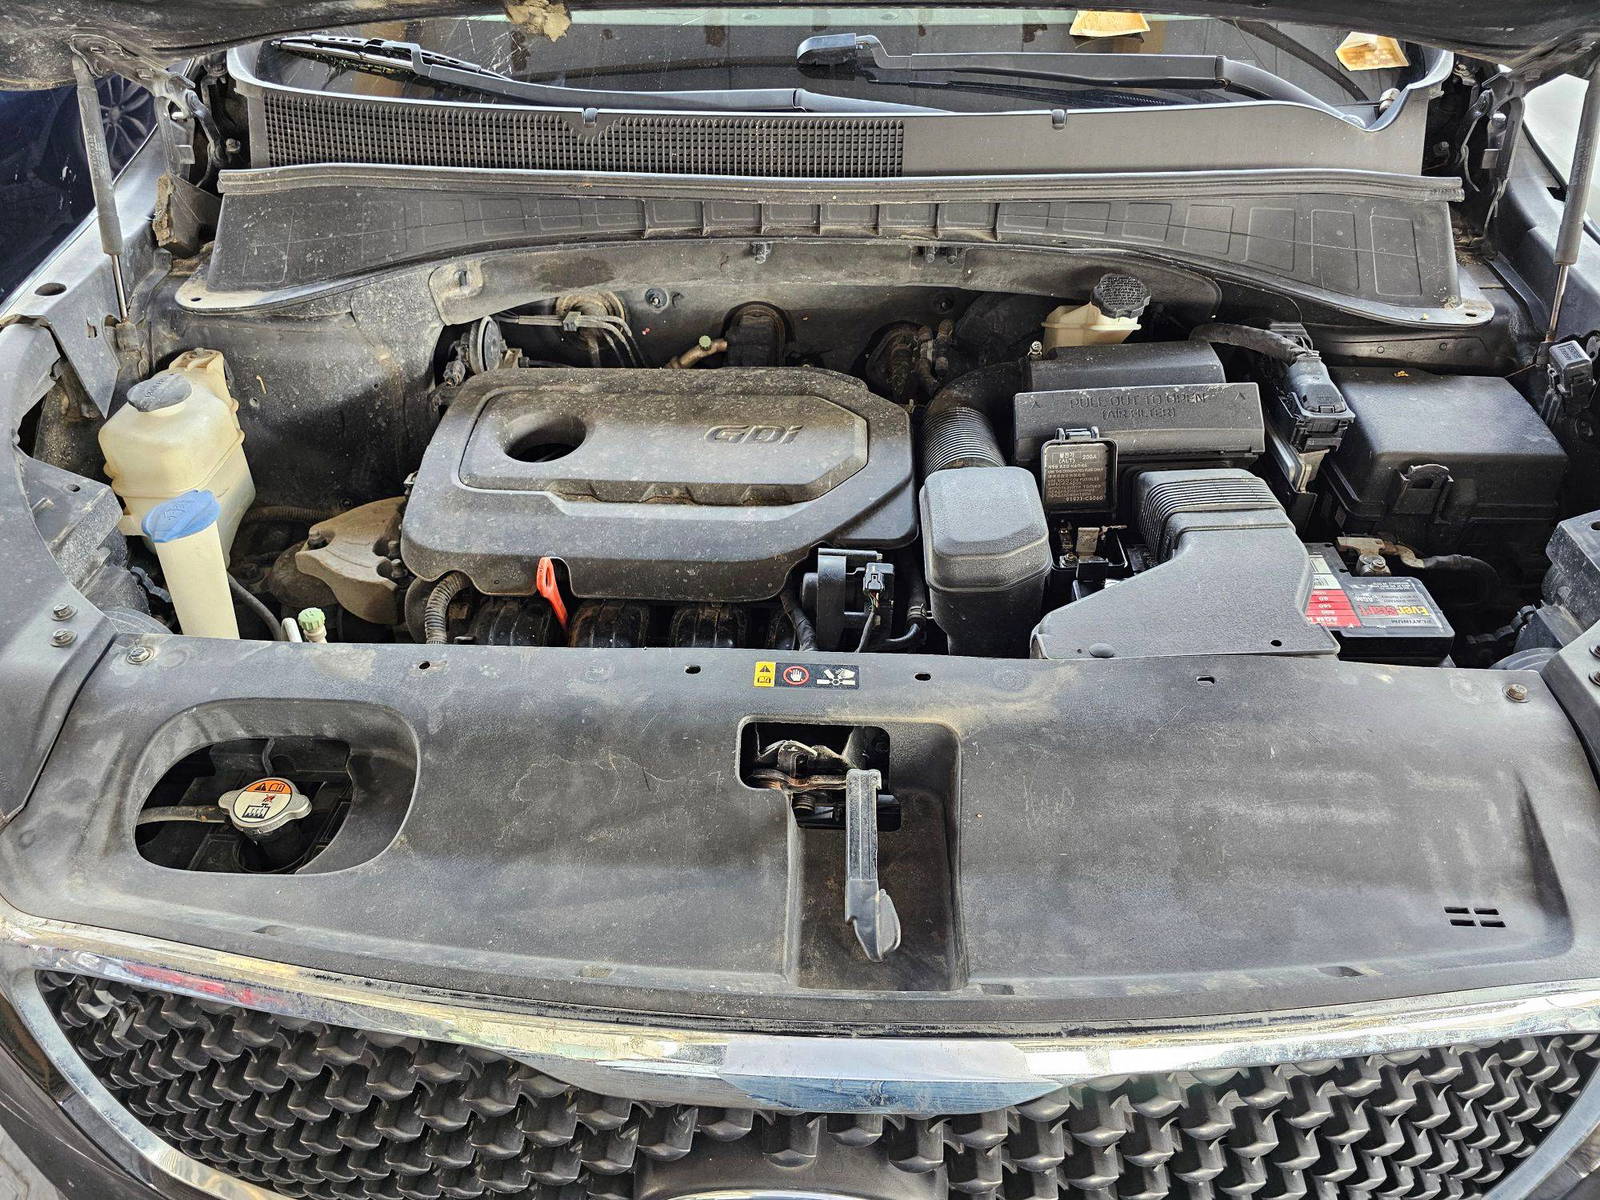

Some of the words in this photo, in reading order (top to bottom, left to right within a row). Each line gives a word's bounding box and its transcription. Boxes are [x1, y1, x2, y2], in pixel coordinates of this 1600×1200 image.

[1070, 396, 1103, 409] PULL
[1110, 394, 1140, 407] OUT
[1144, 393, 1162, 406] TO
[1166, 391, 1207, 405] OPEN
